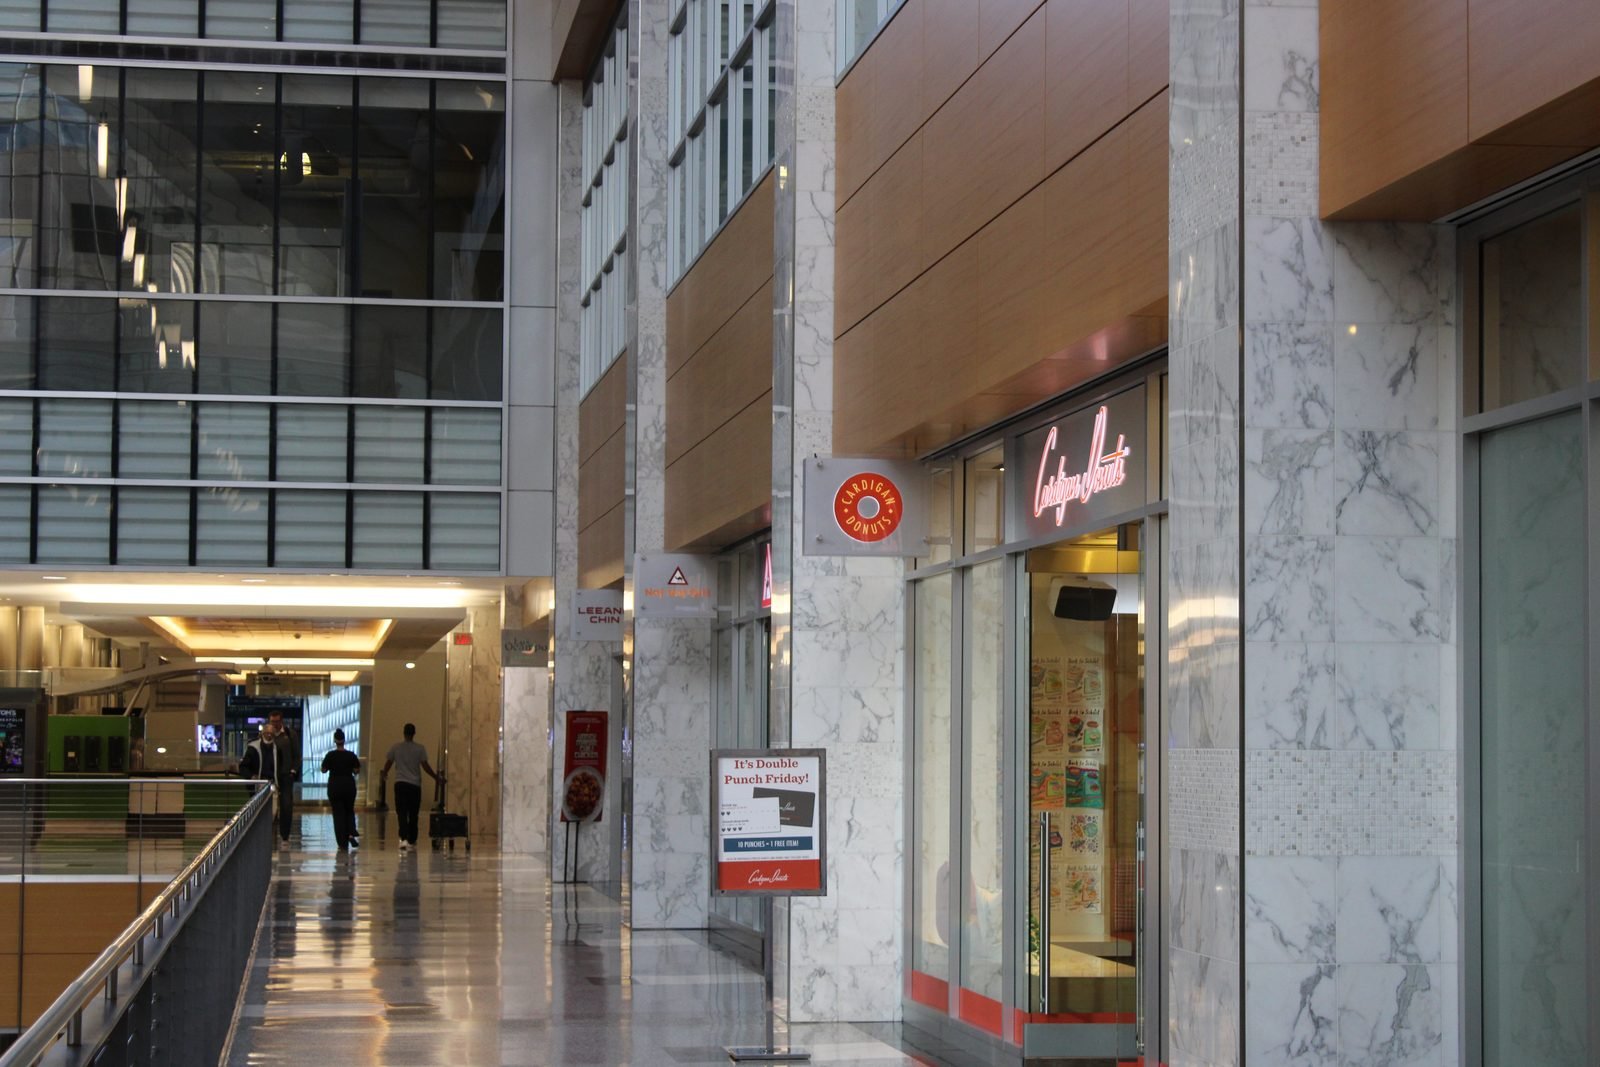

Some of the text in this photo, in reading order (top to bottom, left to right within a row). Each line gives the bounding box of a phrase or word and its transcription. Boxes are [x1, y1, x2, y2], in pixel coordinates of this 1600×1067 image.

[842, 480, 895, 505] CARDIGAN
[846, 516, 891, 535] DONUTS
[578, 607, 624, 615] LEEAN
[590, 616, 620, 624] CHIN
[735, 759, 798, 769] It's Double
[725, 773, 808, 784] Punch Friday!
